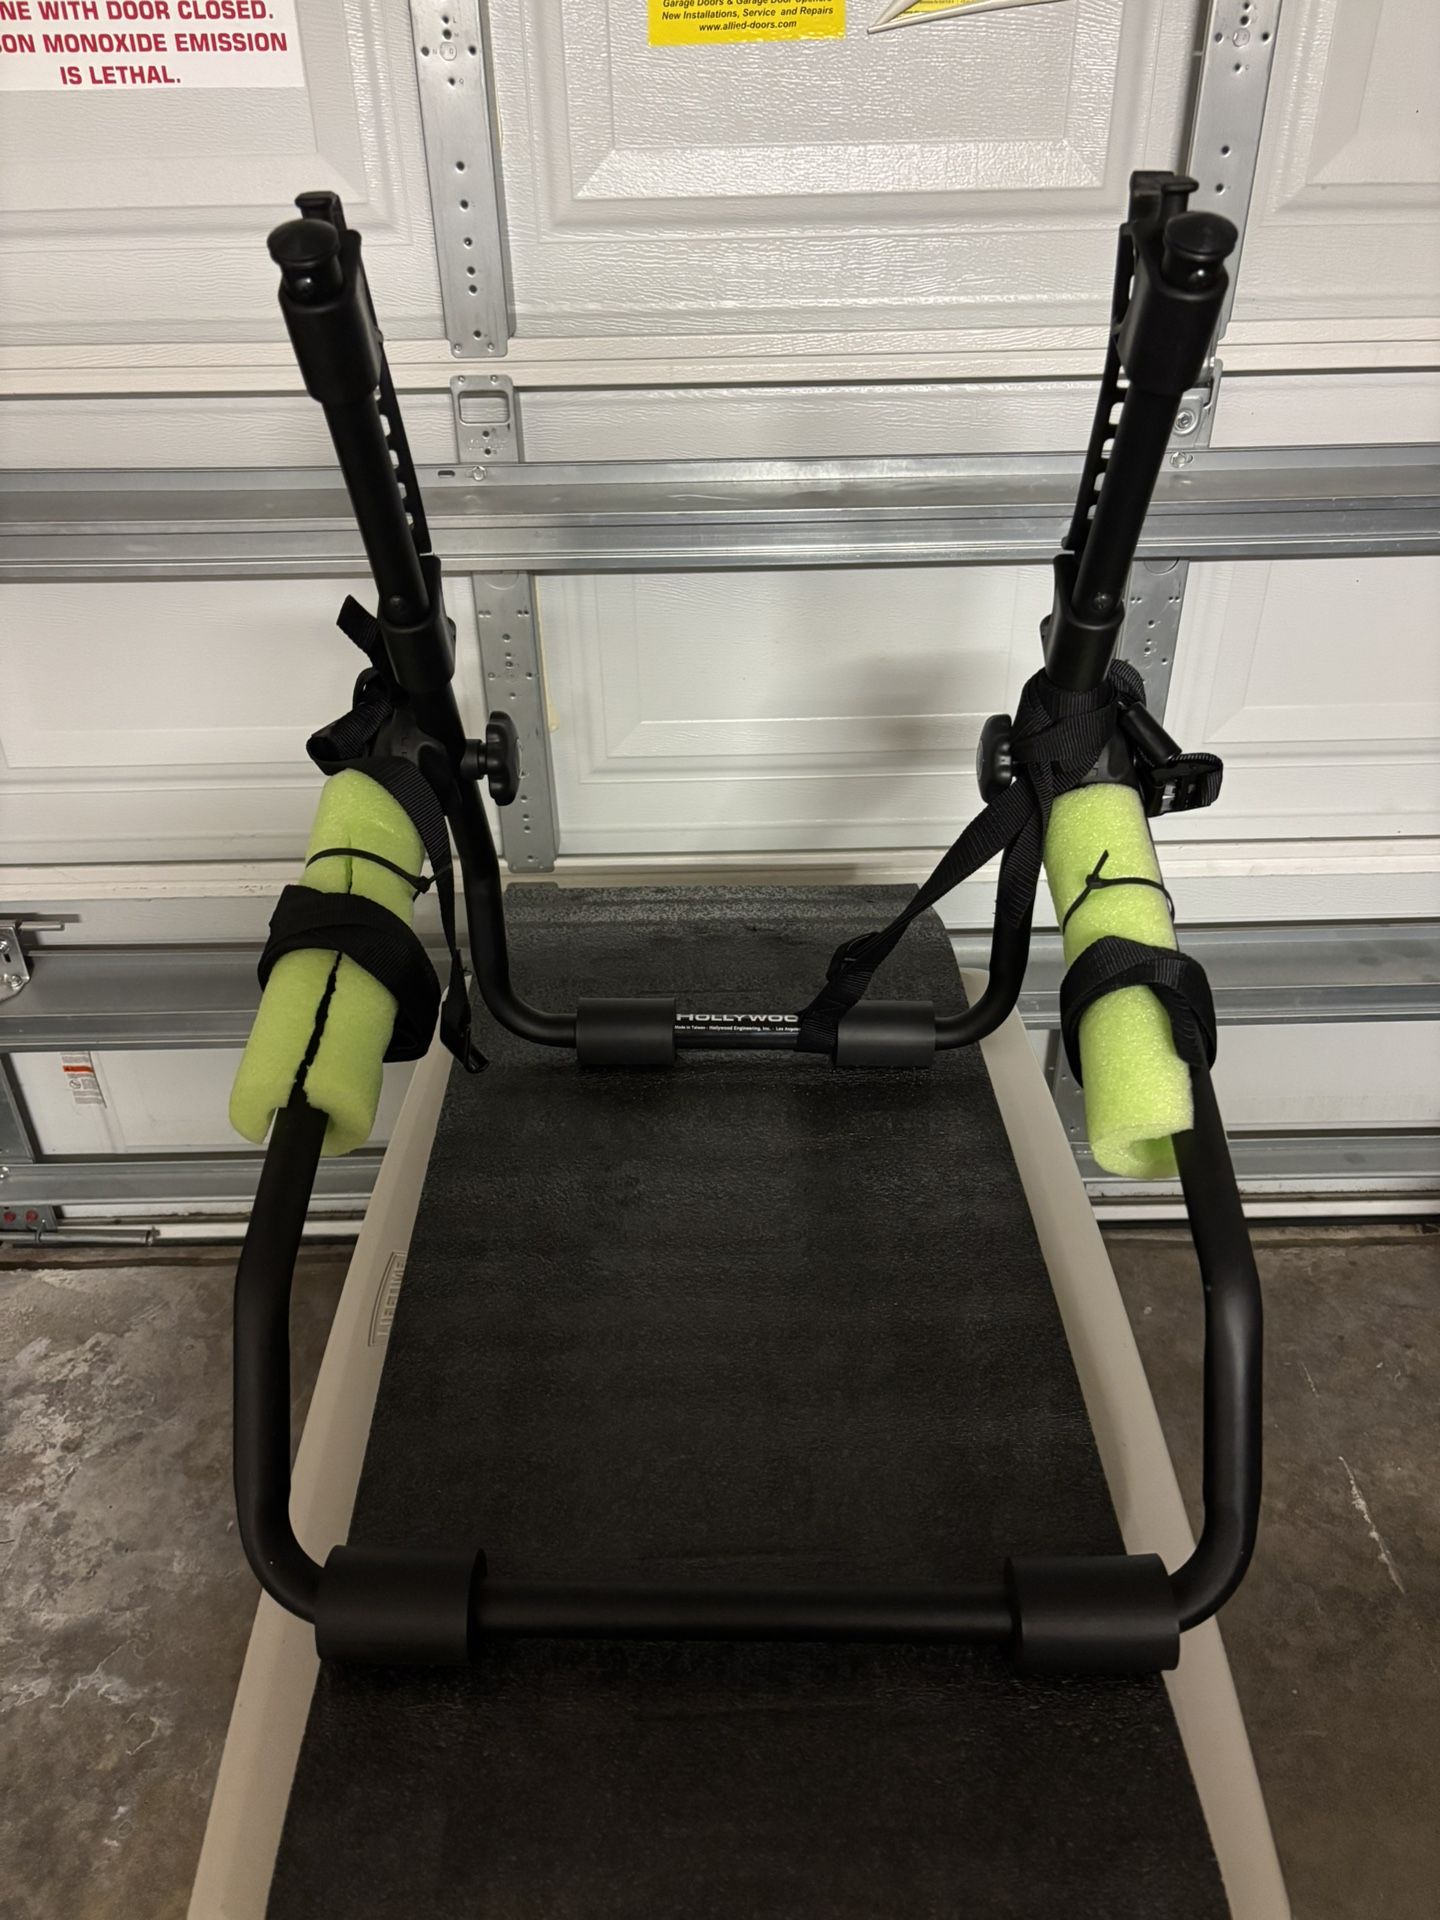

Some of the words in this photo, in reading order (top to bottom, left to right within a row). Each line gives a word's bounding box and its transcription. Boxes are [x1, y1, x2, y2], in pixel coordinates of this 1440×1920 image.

[38, 1, 99, 20] WITH
[106, 0, 170, 20] DOOR
[177, 0, 274, 19] CLOSED.
[662, 11, 681, 20] New
[683, 9, 740, 20] Installations,
[743, 7, 776, 17] Service
[780, 6, 798, 16] and
[800, 6, 834, 16] Repairs
[699, 20, 798, 31] www.allied-doors.com
[0, 34, 36, 53] ON
[42, 33, 168, 53] MONOXIDE
[174, 32, 288, 52] EMISSION
[60, 66, 83, 85] IS
[89, 65, 181, 84] LETHAL.
